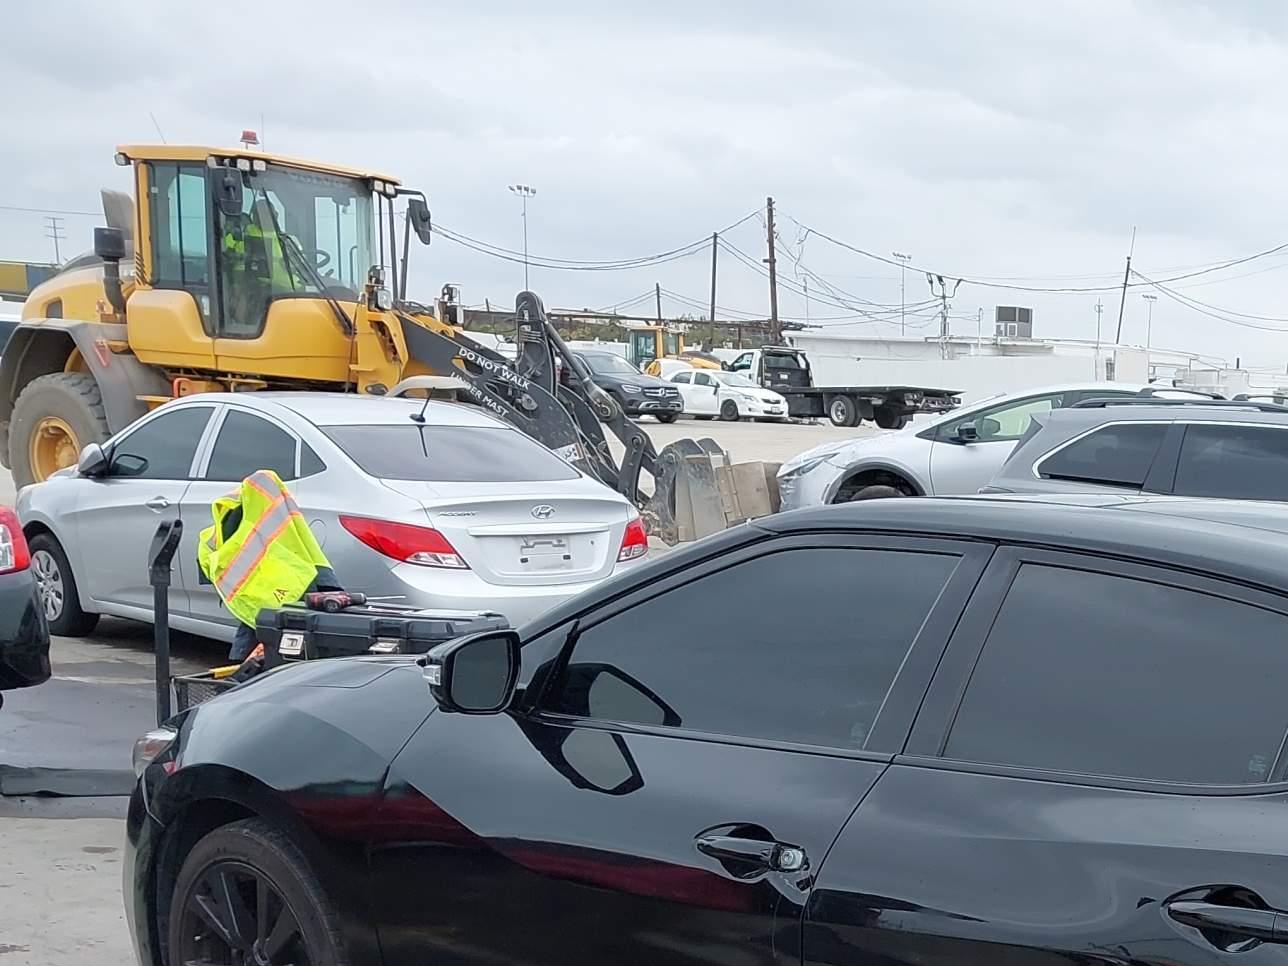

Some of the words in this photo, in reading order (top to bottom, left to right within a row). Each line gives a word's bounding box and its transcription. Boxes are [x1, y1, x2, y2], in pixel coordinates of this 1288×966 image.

[458, 347, 475, 361] DO
[476, 357, 500, 373] NOT
[501, 370, 530, 390] WALK
[482, 396, 509, 417] MAST
